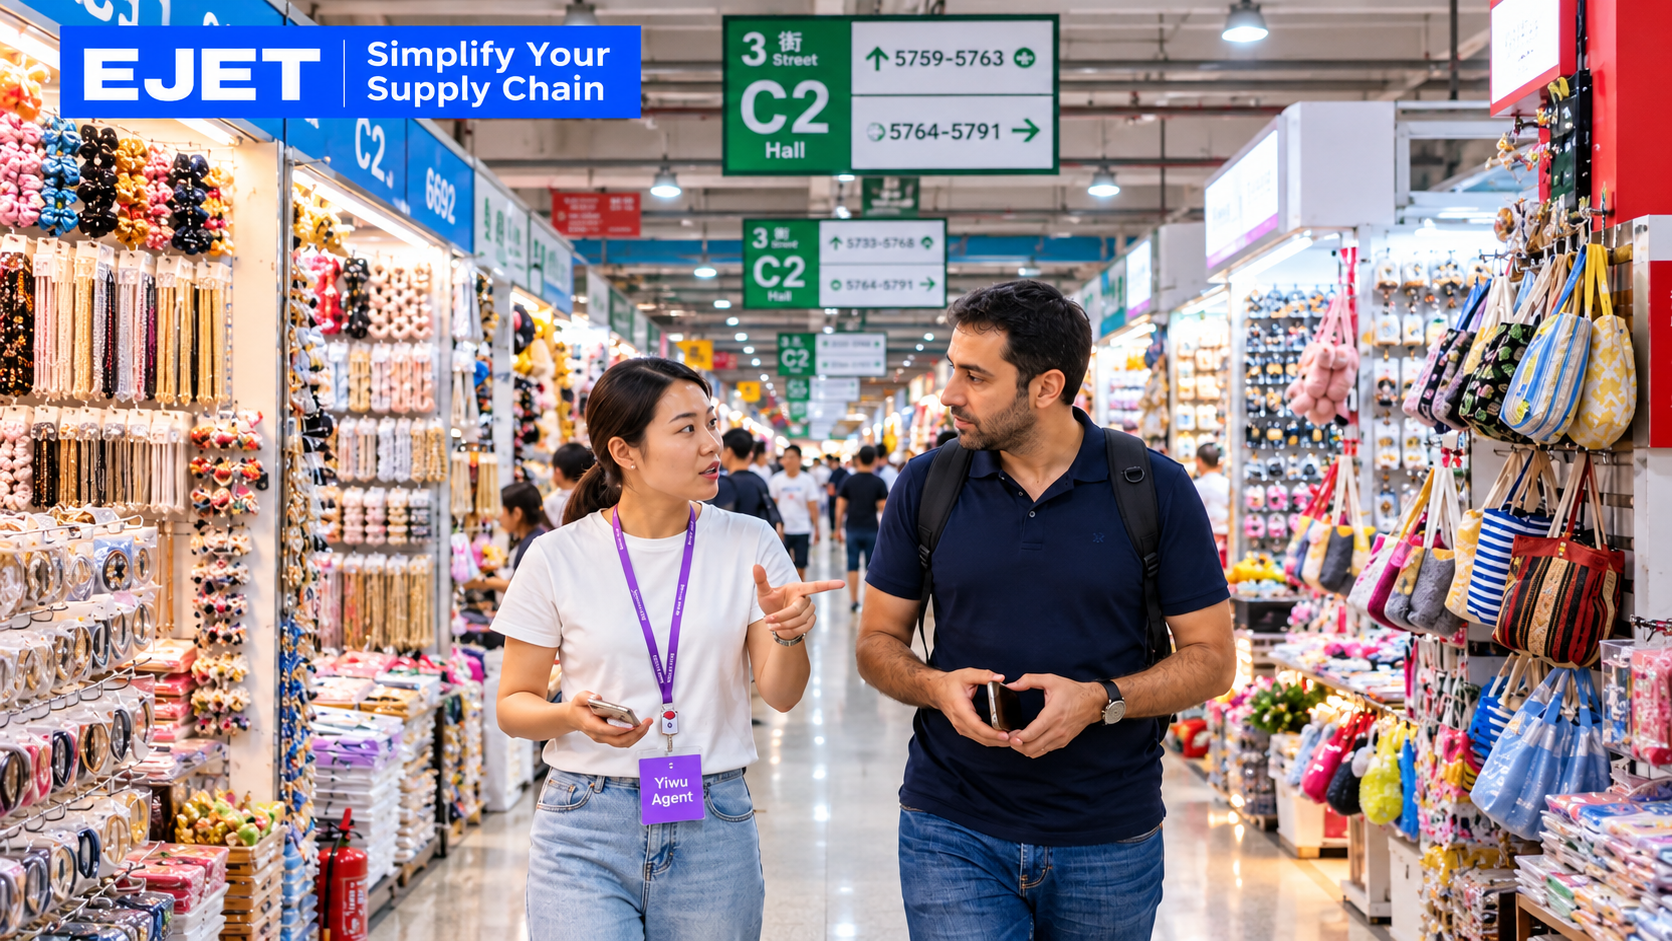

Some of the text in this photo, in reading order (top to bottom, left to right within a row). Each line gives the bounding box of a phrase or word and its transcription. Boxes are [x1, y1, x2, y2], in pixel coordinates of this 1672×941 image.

[741, 30, 802, 67] 3 街
[772, 53, 818, 67] Street
[895, 50, 1004, 67] 5759-5763
[740, 79, 829, 135] C2
[890, 123, 1000, 140] 5764-5791
[765, 141, 805, 159] Hall
[425, 167, 456, 226] 6692
[752, 227, 768, 249] 3
[753, 254, 806, 288] C2
[767, 290, 793, 302] Hall
[781, 348, 810, 368] C2
[654, 776, 689, 789] Yiwu
[651, 791, 694, 808] Agent
